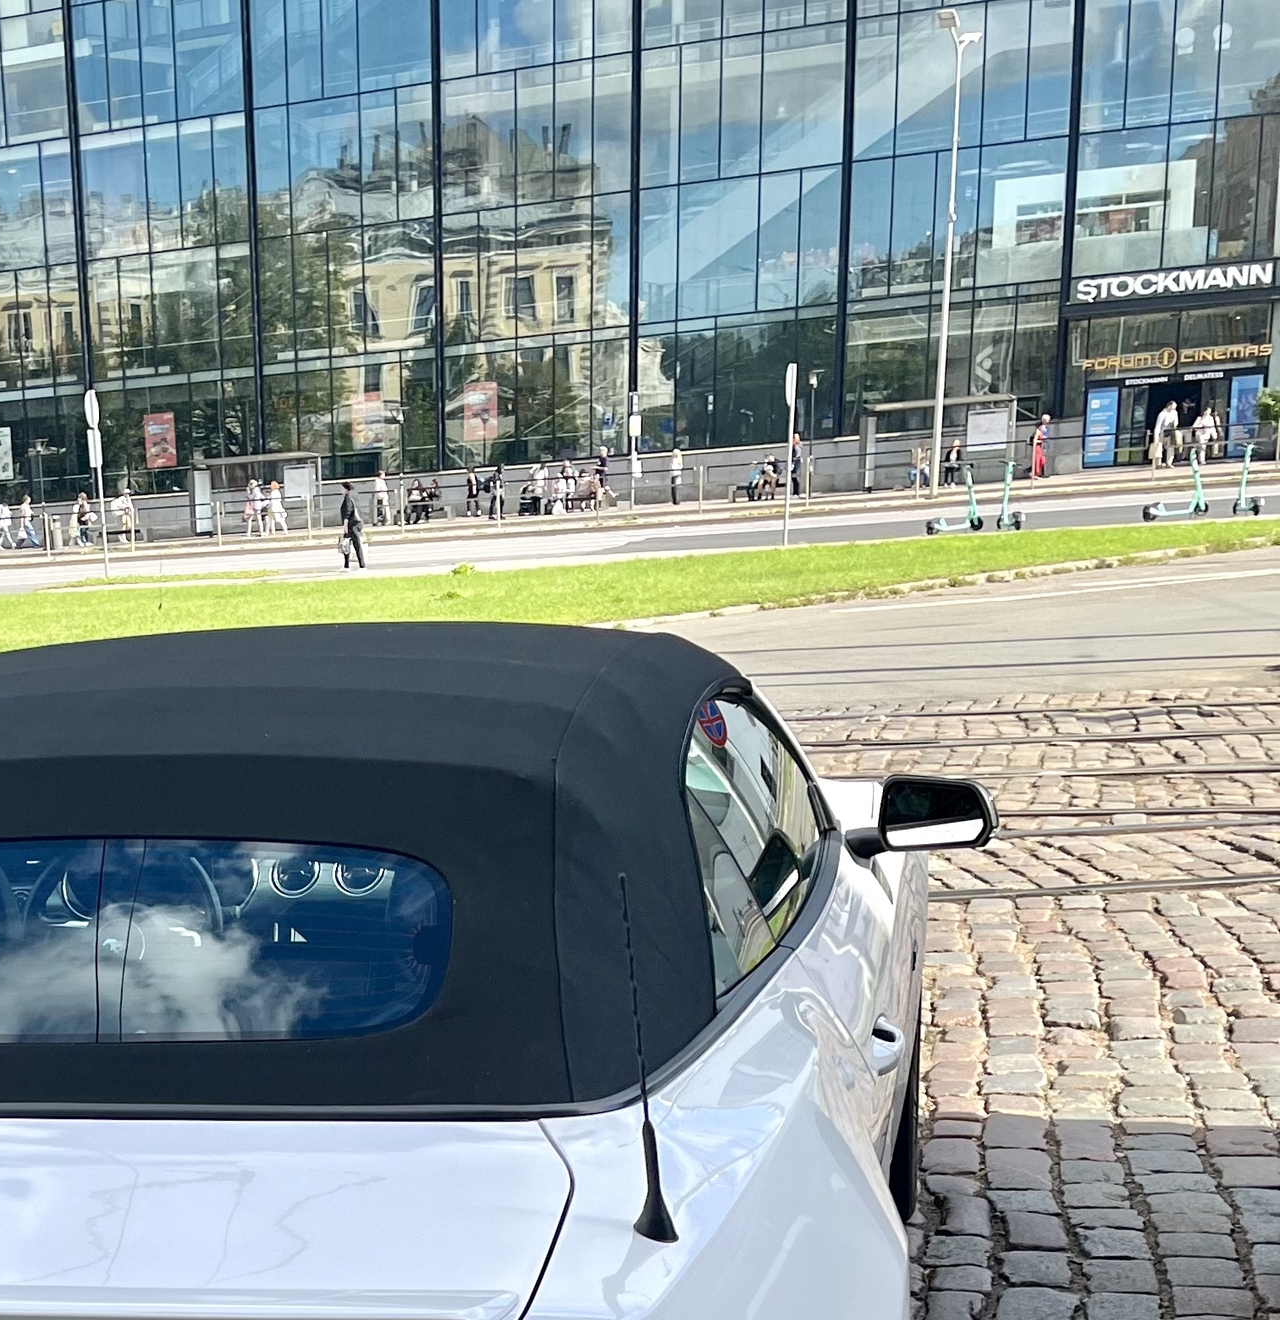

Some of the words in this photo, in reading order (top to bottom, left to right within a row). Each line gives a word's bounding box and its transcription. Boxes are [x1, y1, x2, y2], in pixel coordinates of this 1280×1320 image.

[1077, 263, 1273, 302] STOCKMANN
[1082, 354, 1152, 371] FORUM
[1180, 344, 1273, 363] CINEMAS
